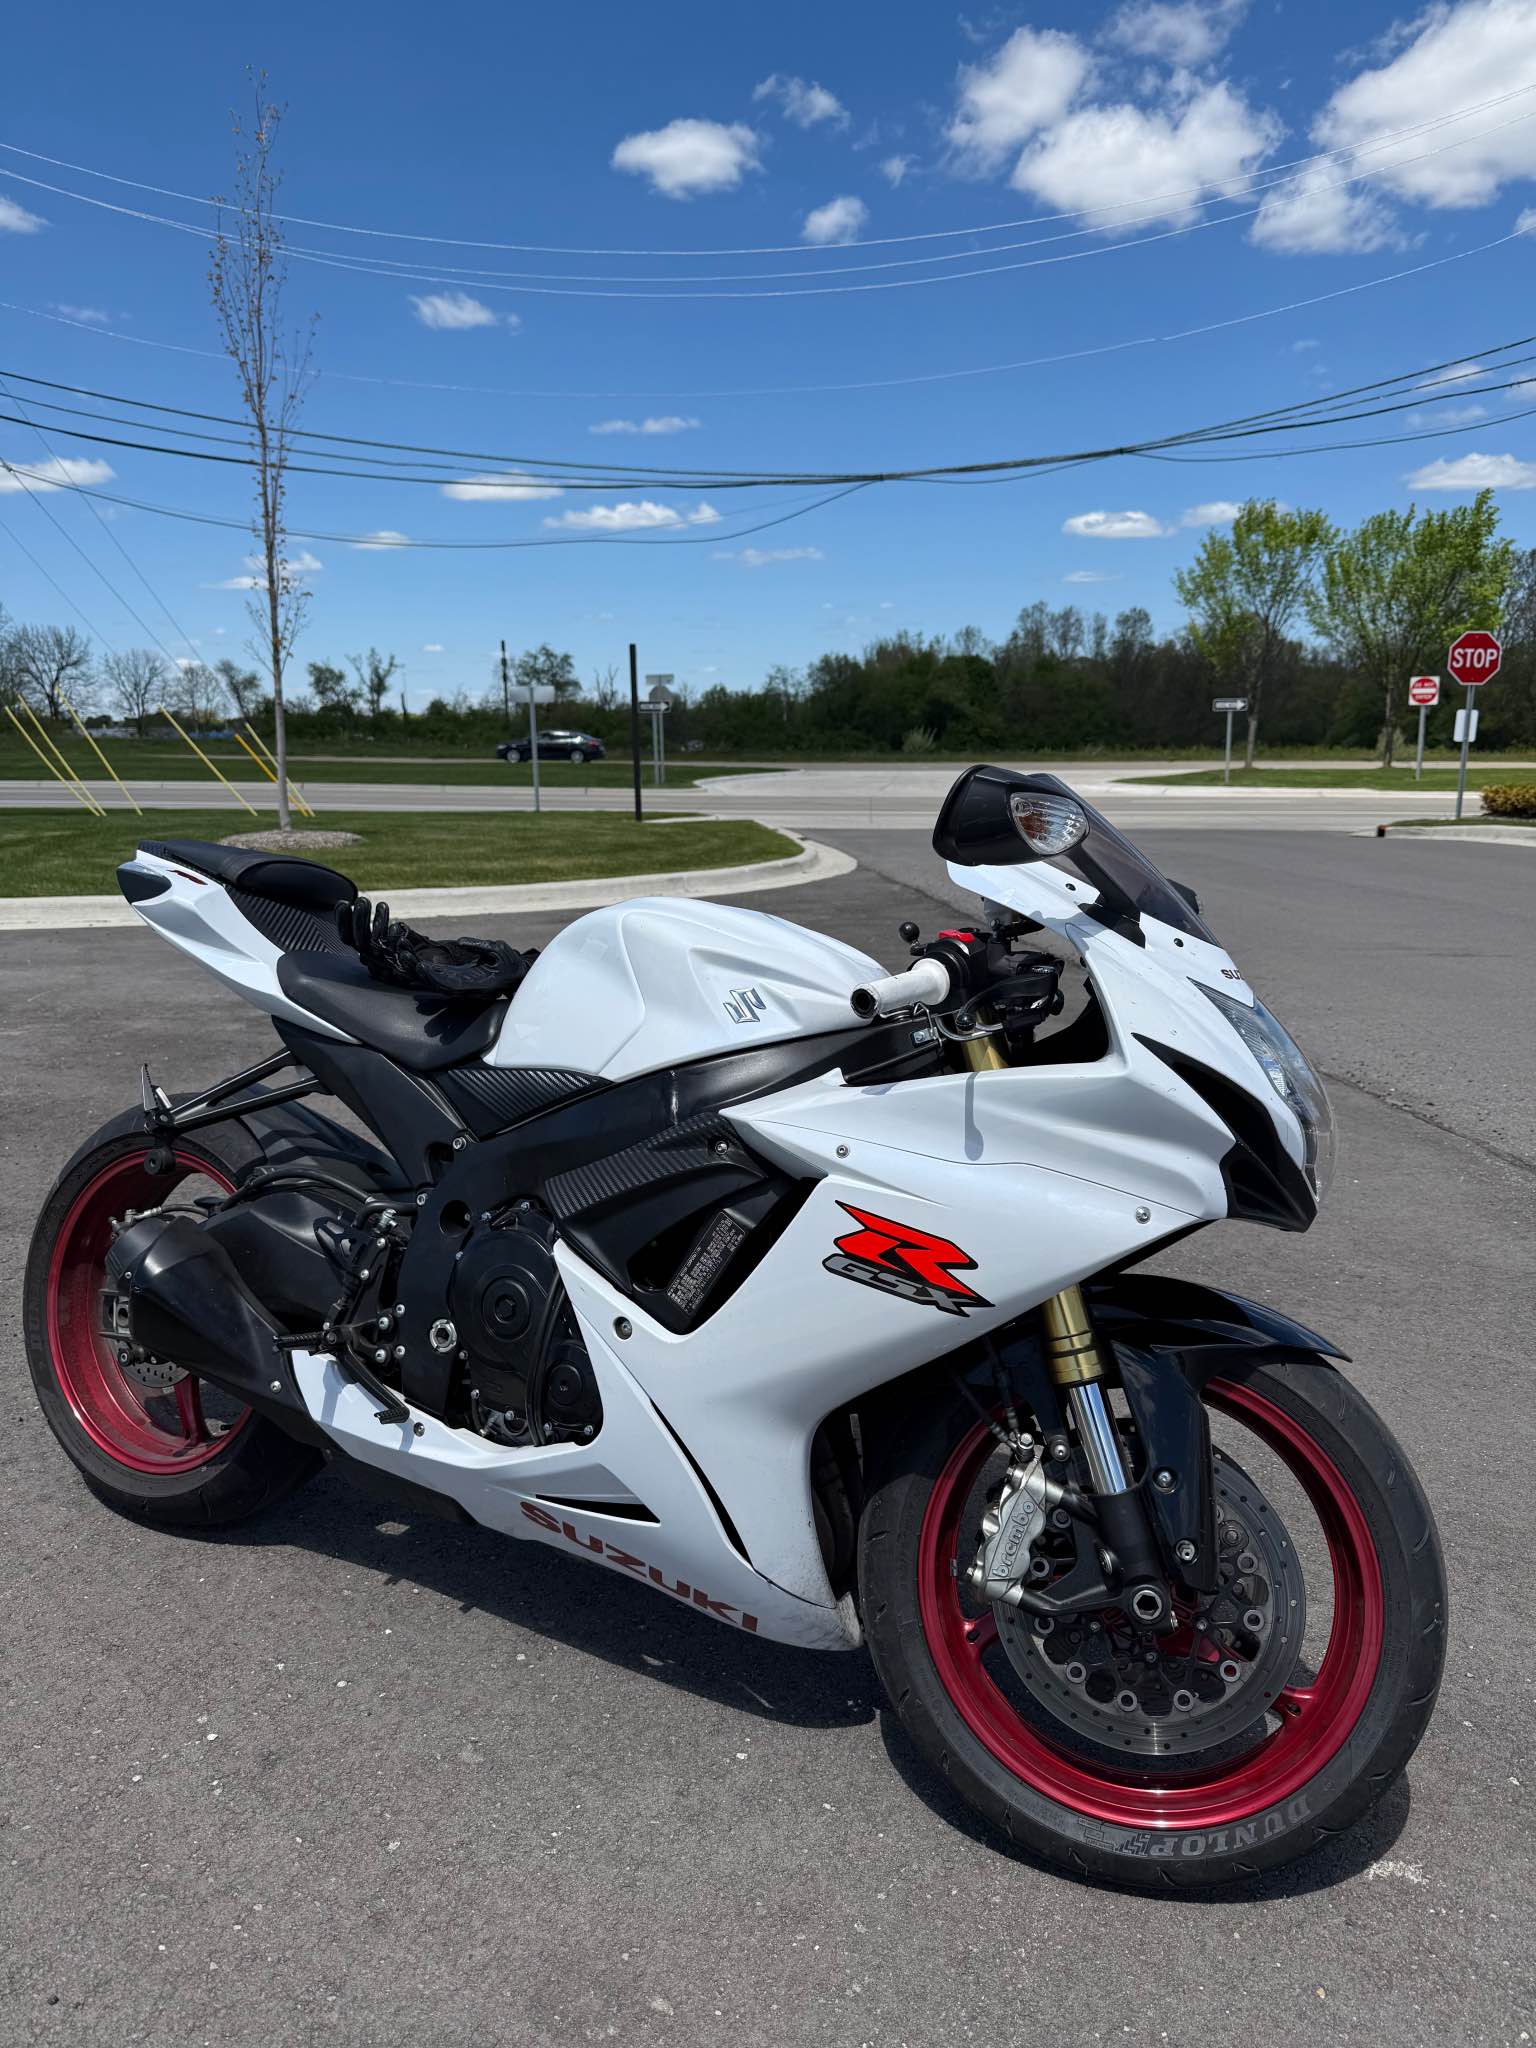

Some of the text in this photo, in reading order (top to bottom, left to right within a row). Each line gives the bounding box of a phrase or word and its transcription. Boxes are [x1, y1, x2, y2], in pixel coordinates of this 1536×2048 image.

[1452, 648, 1498, 668] STOP
[520, 1501, 758, 1632] SUZUKI
[992, 1501, 1035, 1577] brembo
[1150, 1796, 1311, 1857] DUNLOP
